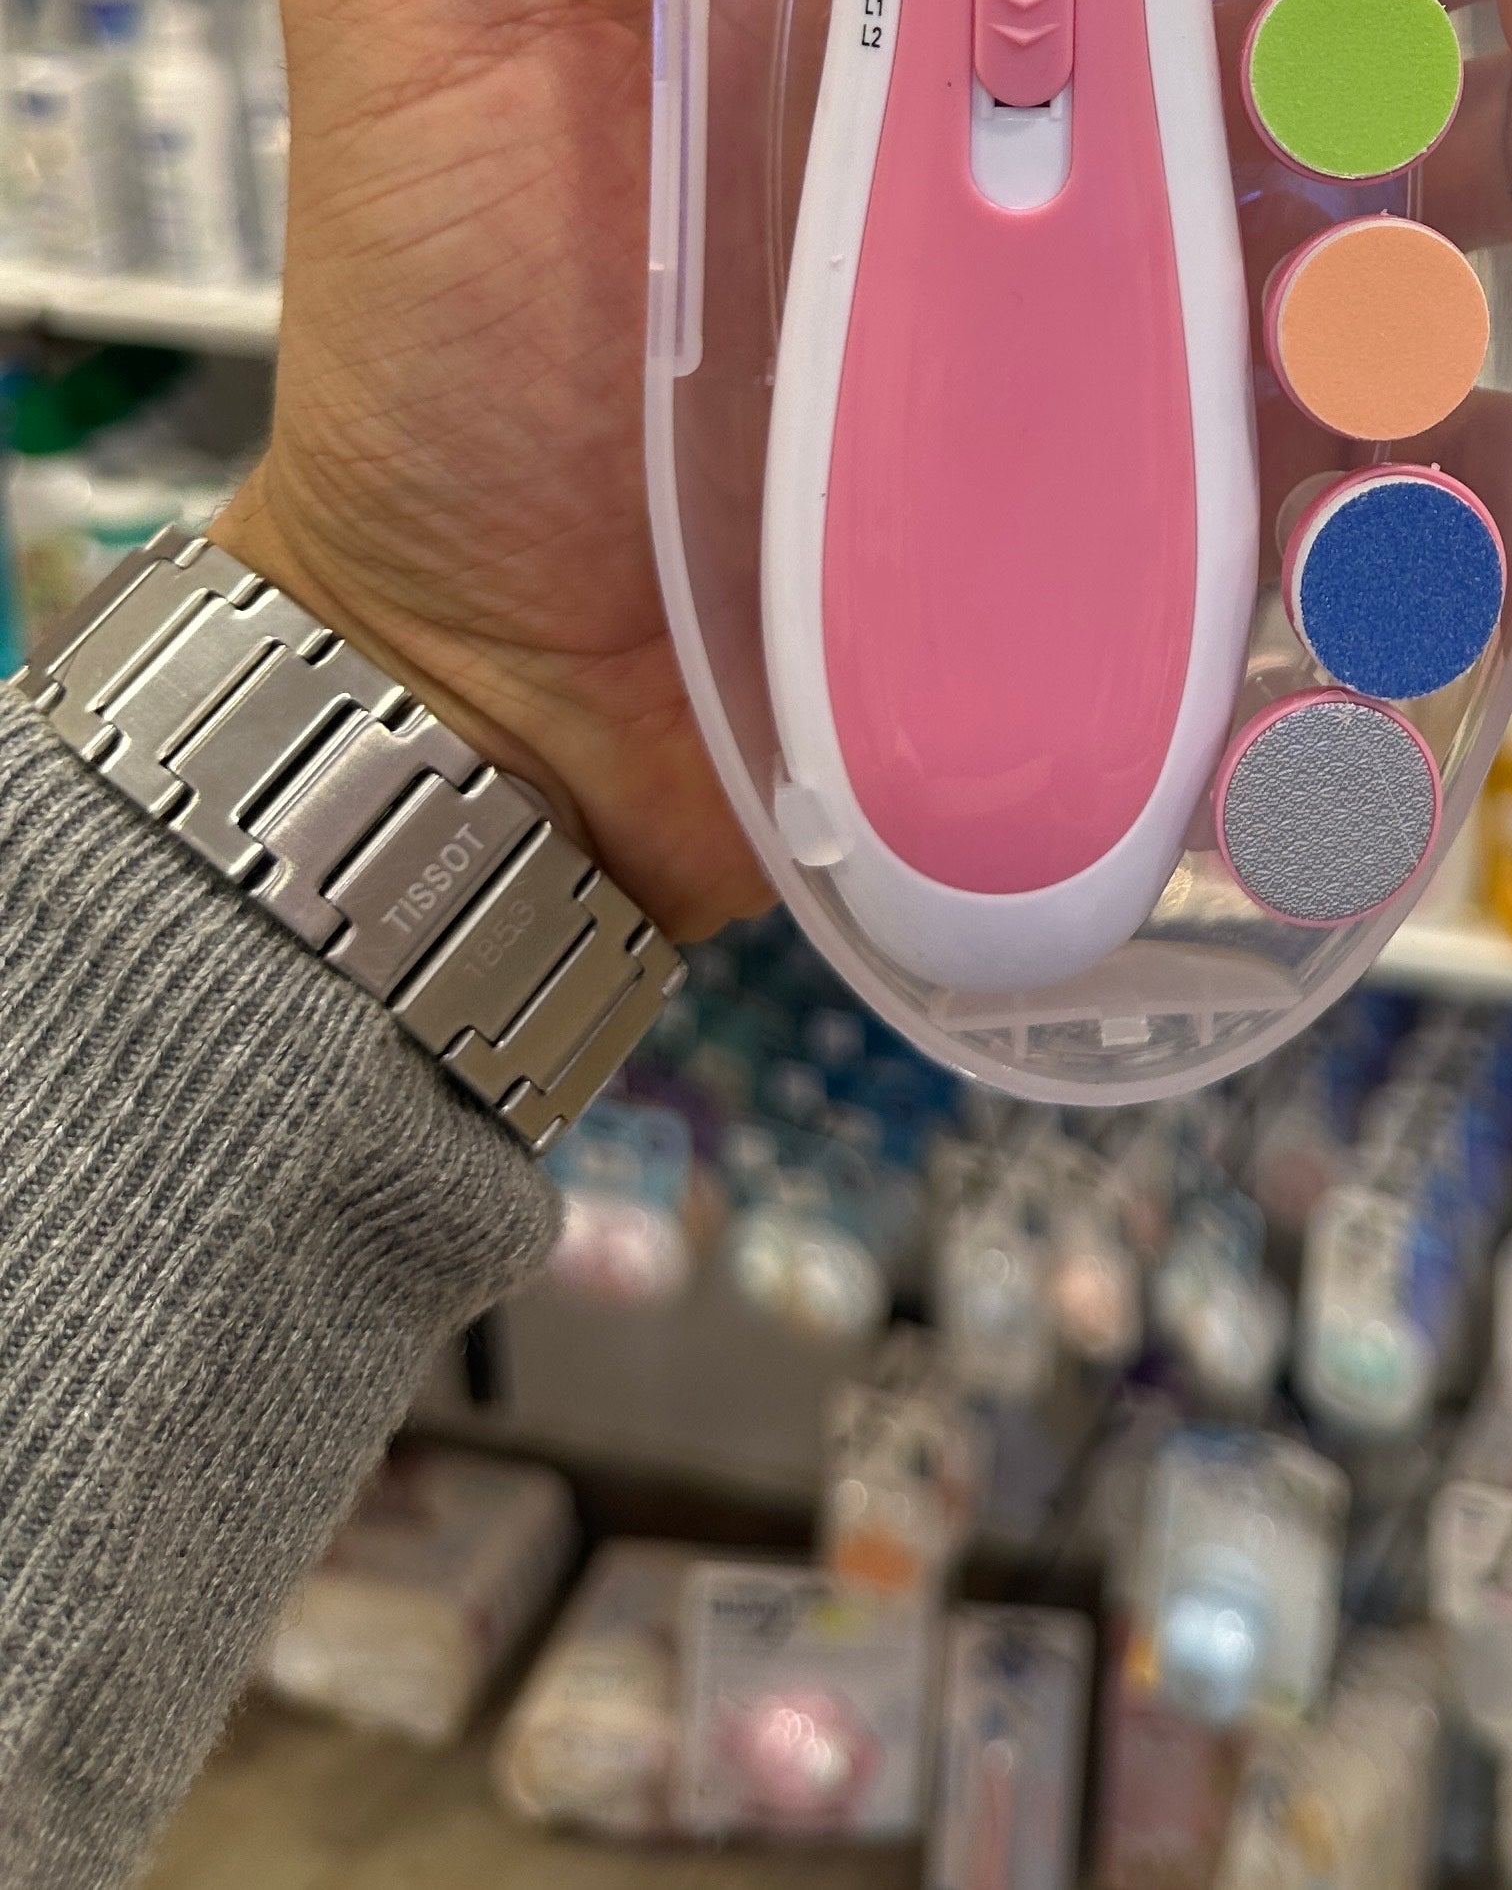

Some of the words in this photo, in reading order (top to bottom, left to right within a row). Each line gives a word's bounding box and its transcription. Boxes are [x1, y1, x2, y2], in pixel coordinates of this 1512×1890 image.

[861, 23, 881, 48] L2
[380, 823, 486, 936] TISSOT
[463, 898, 537, 979] 1853
